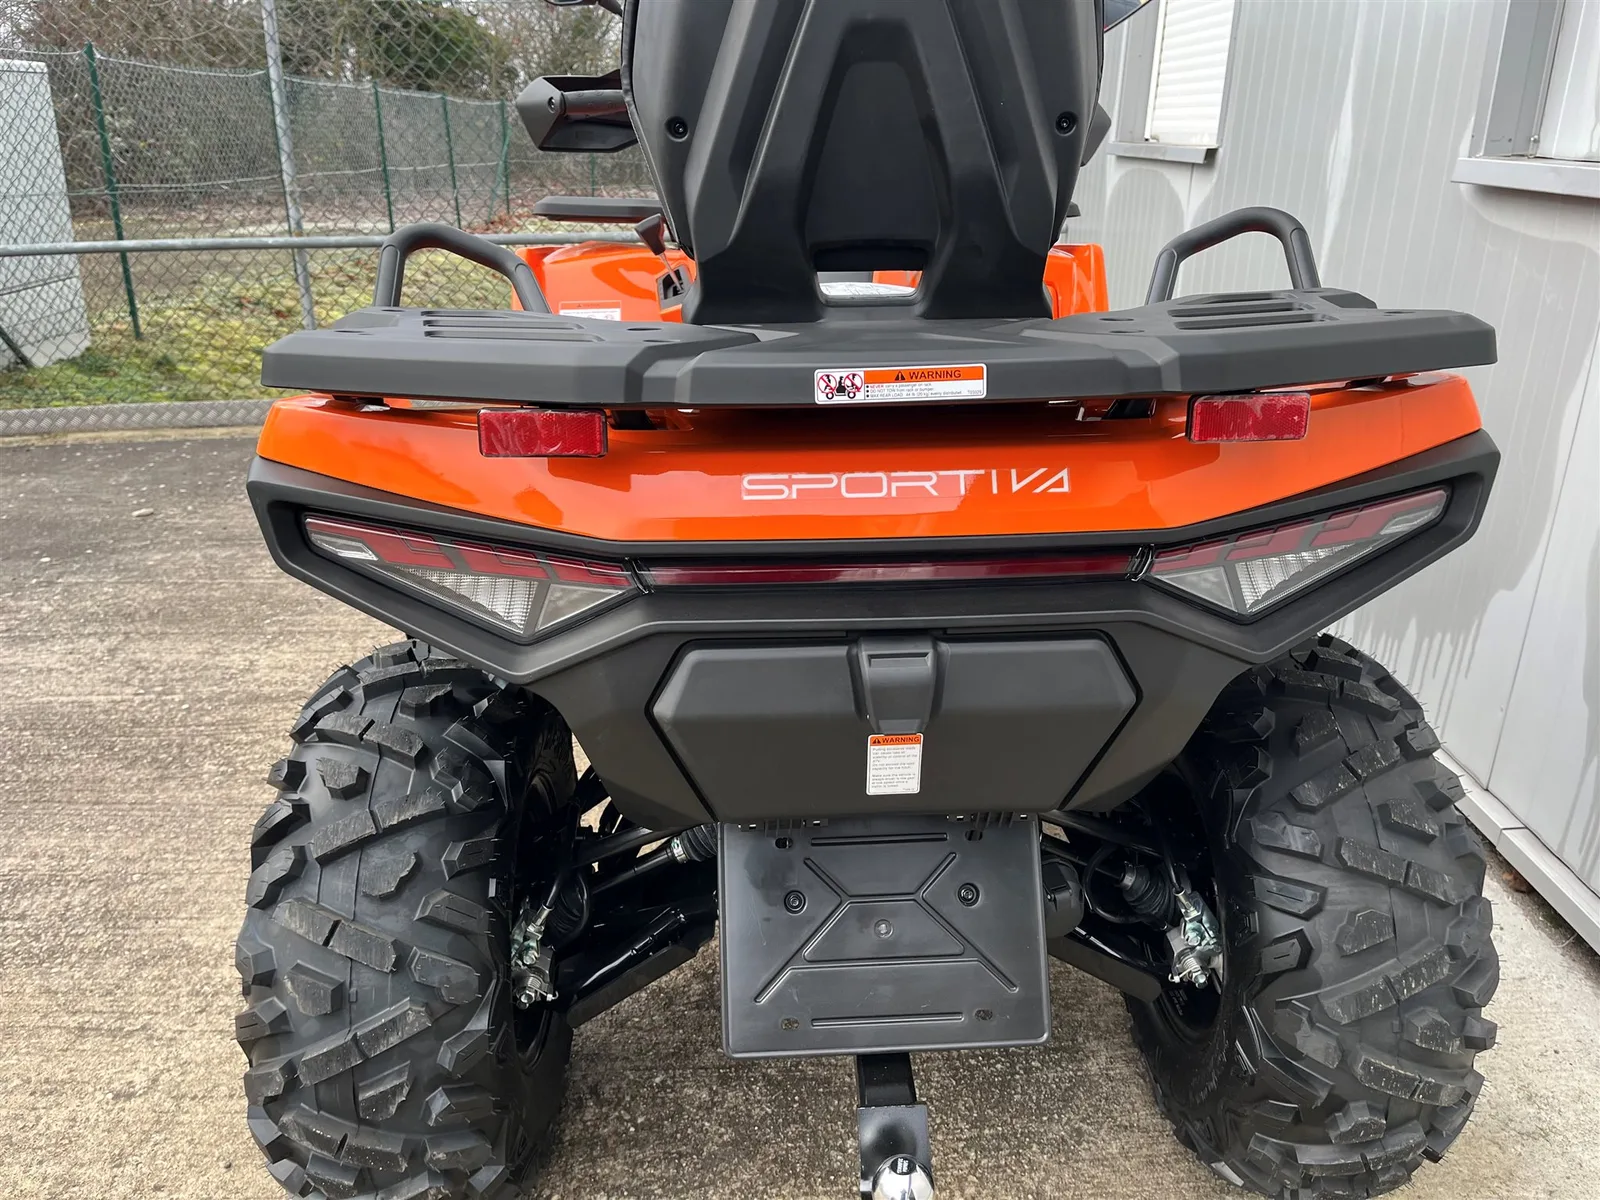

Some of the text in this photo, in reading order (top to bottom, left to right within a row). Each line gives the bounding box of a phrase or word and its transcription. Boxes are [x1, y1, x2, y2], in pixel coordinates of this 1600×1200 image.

[908, 369, 962, 380] WARNING
[742, 467, 1070, 500] SPORTIVA
[882, 736, 920, 744] WARNING
